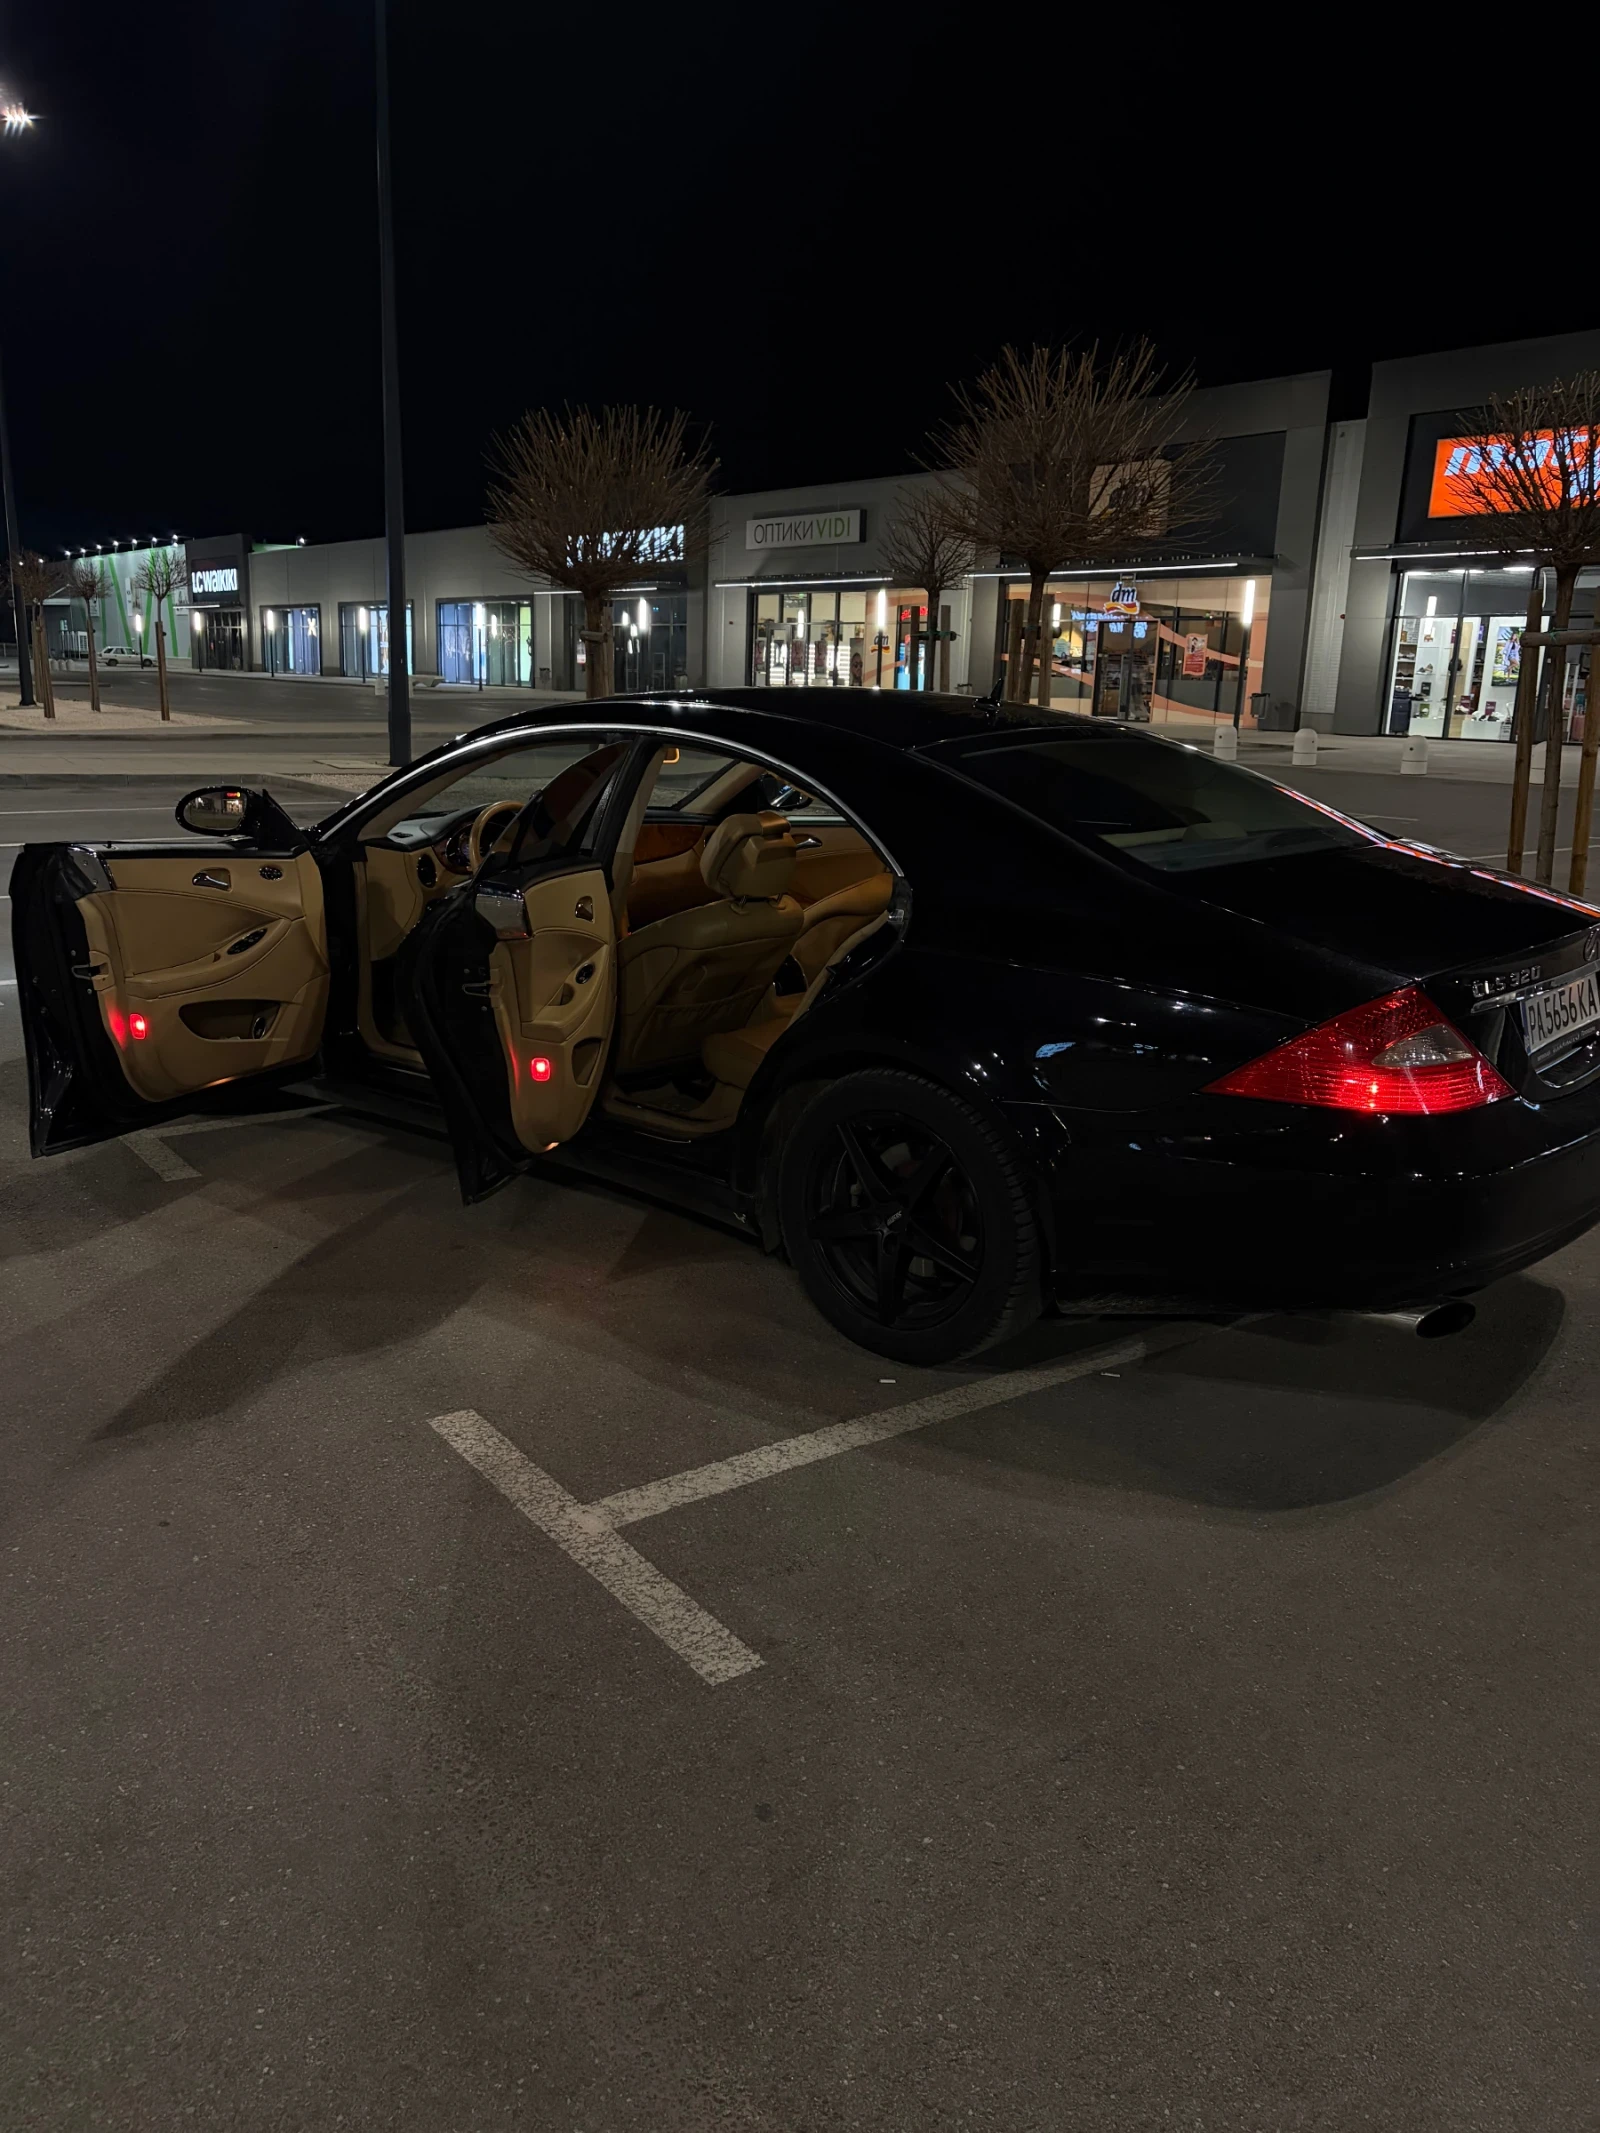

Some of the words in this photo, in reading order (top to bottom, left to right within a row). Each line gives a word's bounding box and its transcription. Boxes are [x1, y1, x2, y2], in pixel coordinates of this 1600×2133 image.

[754, 520, 814, 544] ОПТИКИ
[816, 516, 851, 539] VIDI
[1112, 583, 1136, 603] dm
[1472, 976, 1506, 999] CLS
[1510, 965, 1541, 987] 320
